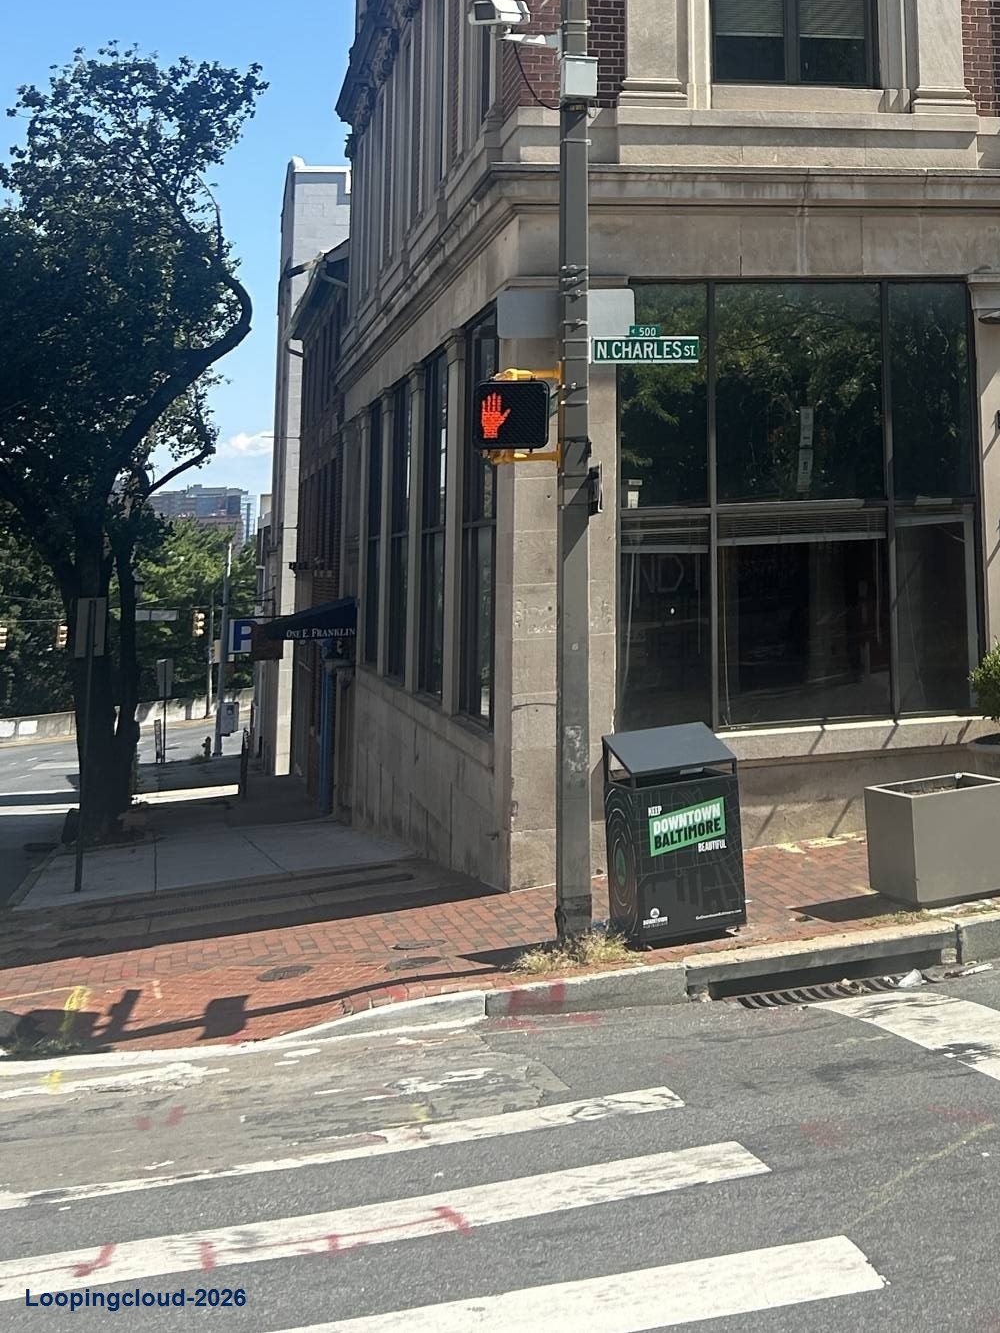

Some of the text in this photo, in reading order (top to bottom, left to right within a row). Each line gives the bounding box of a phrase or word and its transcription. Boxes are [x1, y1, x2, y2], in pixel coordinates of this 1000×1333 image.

[639, 327, 656, 336] 500
[597, 341, 696, 358] N. CHARLES ST.
[233, 620, 257, 651] P
[286, 629, 301, 638] ONE
[312, 627, 356, 638] FRANKLIN
[648, 805, 662, 816] KEEP
[653, 803, 721, 836] DOWNTOWN
[654, 818, 721, 850] BALTIMORE
[698, 839, 727, 852] BEAUTIFUL
